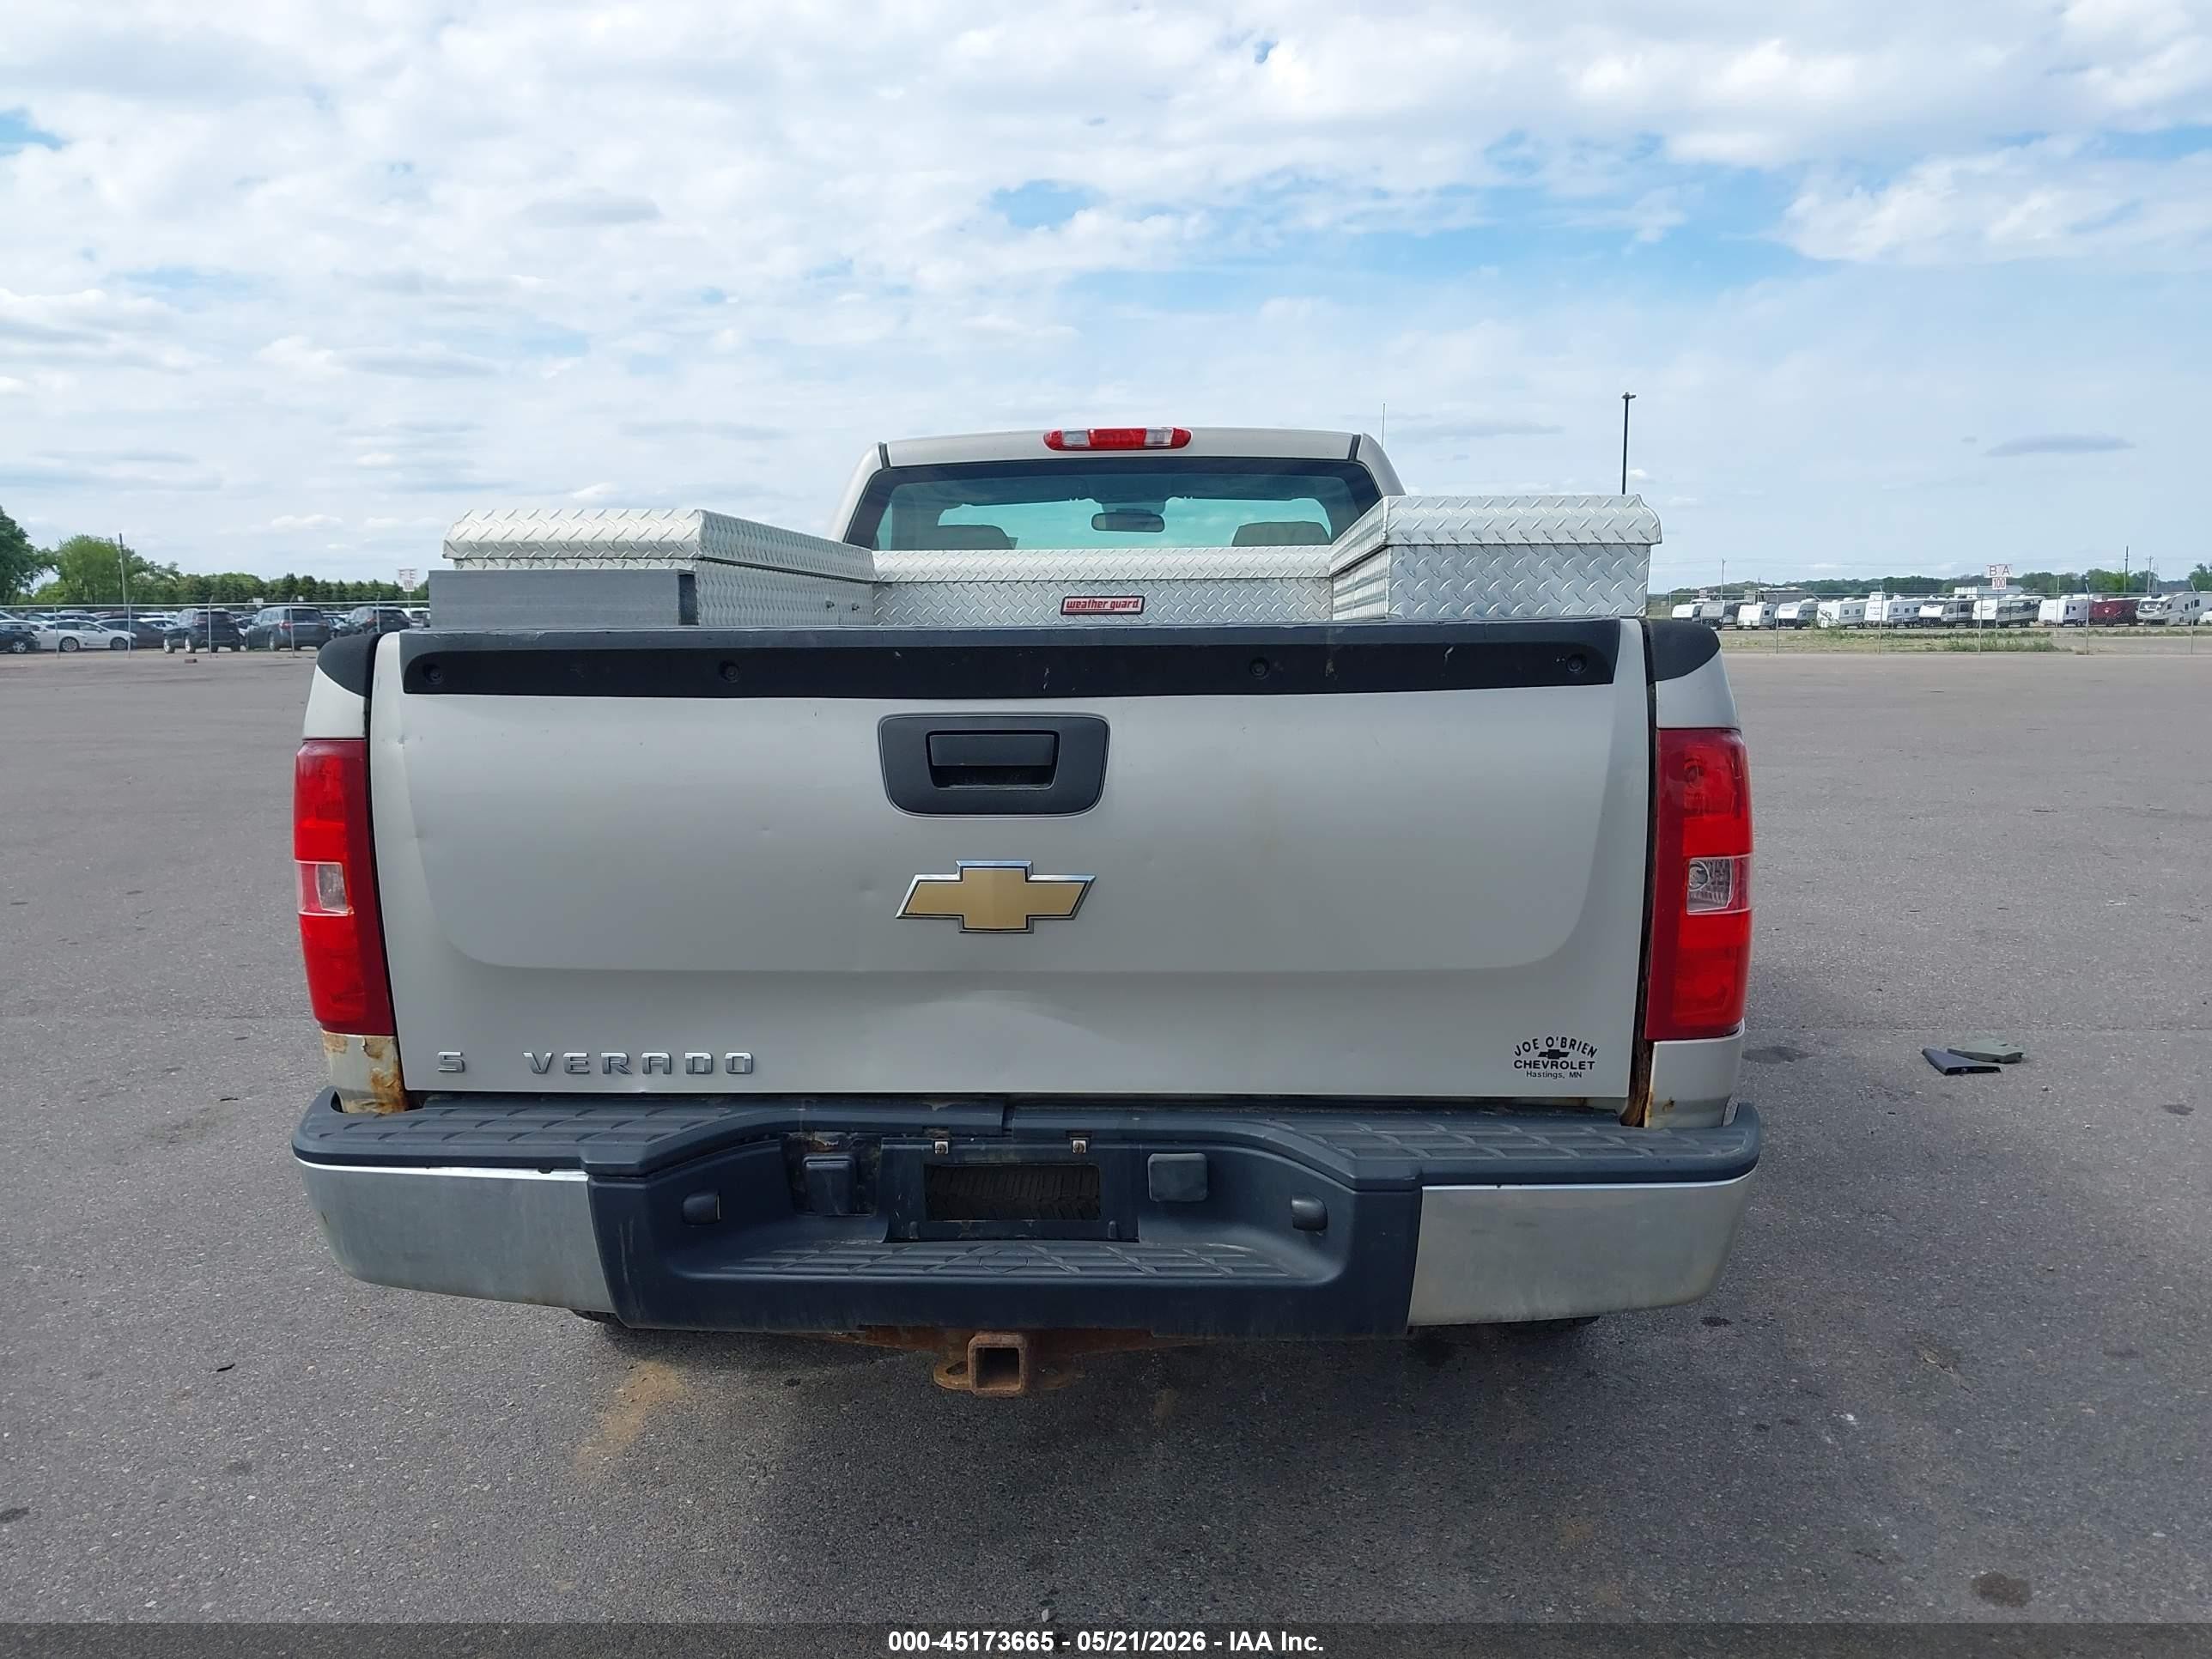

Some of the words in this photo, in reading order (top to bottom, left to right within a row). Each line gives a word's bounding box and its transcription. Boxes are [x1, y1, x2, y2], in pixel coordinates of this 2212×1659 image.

[1066, 599, 1109, 609] weather
[1109, 599, 1139, 611] guard
[1514, 1038, 1540, 1057] JOE
[1545, 1036, 1598, 1058] O'BRIEN
[1513, 1060, 1595, 1070] CHEVROLET
